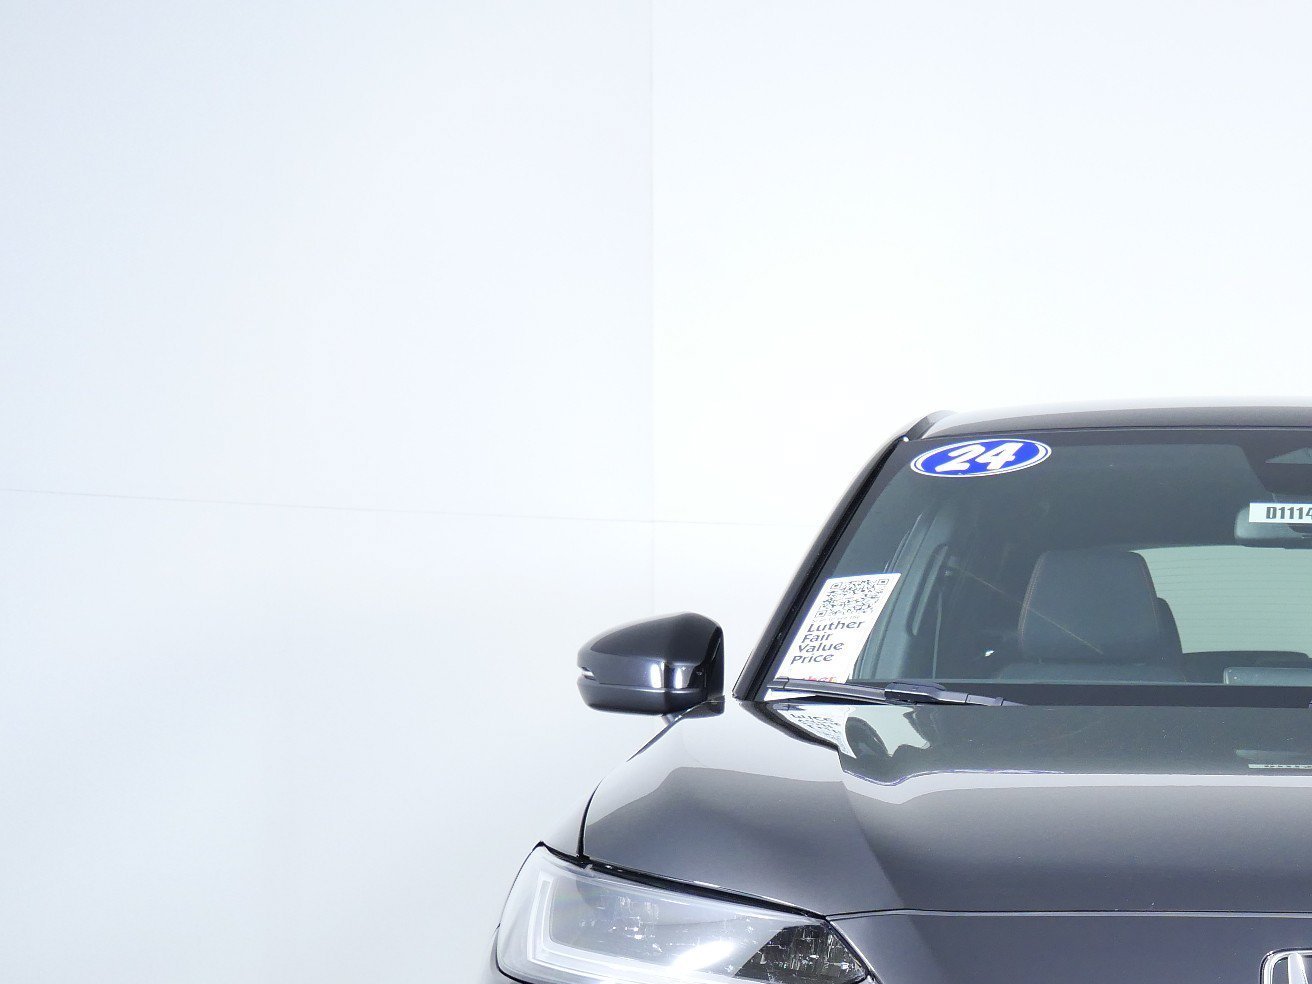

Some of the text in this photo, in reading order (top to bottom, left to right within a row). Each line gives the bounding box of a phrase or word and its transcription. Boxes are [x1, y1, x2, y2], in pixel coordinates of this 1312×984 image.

[934, 441, 1025, 472] 24
[807, 621, 864, 633] Luther
[801, 632, 833, 643] Fair
[798, 642, 845, 653] Value
[790, 653, 835, 665] Price
